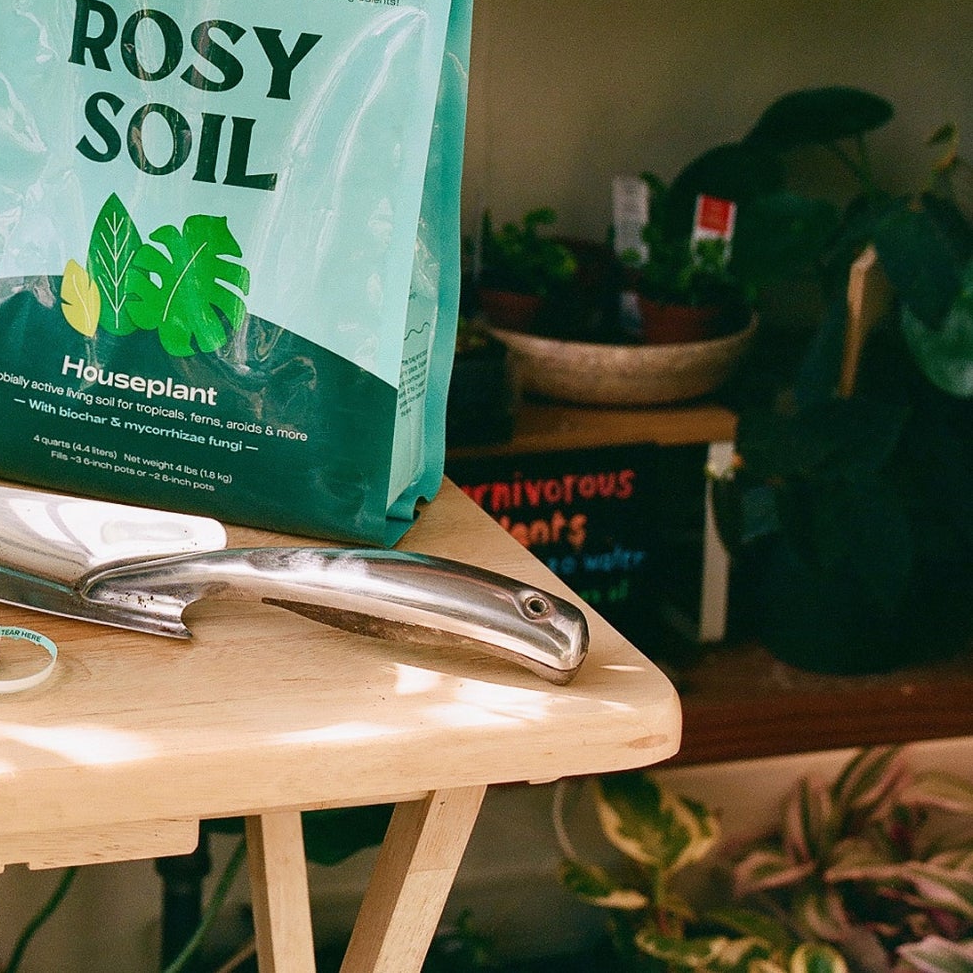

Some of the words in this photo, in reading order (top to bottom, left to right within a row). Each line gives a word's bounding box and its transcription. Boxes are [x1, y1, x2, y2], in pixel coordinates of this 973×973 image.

[75, 91, 278, 192] SOIL
[61, 354, 218, 406] Houseplant
[28, 398, 56, 415] With
[59, 406, 108, 425] biochar
[110, 416, 122, 428] &
[124, 420, 206, 445] mycorrhizae
[208, 435, 243, 452] fungi
[31, 380, 65, 396] active
[66, 386, 93, 405] living
[95, 395, 115, 407] soil
[117, 398, 133, 410] for
[136, 402, 188, 422] tropicals,
[190, 412, 224, 428] ferns,
[226, 419, 262, 434] aroids
[265, 425, 275, 436] &
[276, 429, 308, 442] more
[33, 434, 40, 442] 4
[41, 436, 71, 449] quarts
[72, 442, 90, 452] (4.4
[91, 447, 117, 460] liters)
[124, 453, 141, 464] Net
[142, 458, 174, 471] weight
[175, 464, 182, 472] 4
[183, 465, 198, 476] lbs
[199, 468, 216, 479] (1.8
[217, 472, 233, 484] kg)
[50, 450, 68, 461] Fills
[83, 457, 113, 470] 6-inch
[114, 465, 135, 475] pots
[136, 469, 147, 477] or
[193, 481, 215, 492] pots
[461, 469, 636, 513] rnivorous
[21, 631, 42, 642] HERE
